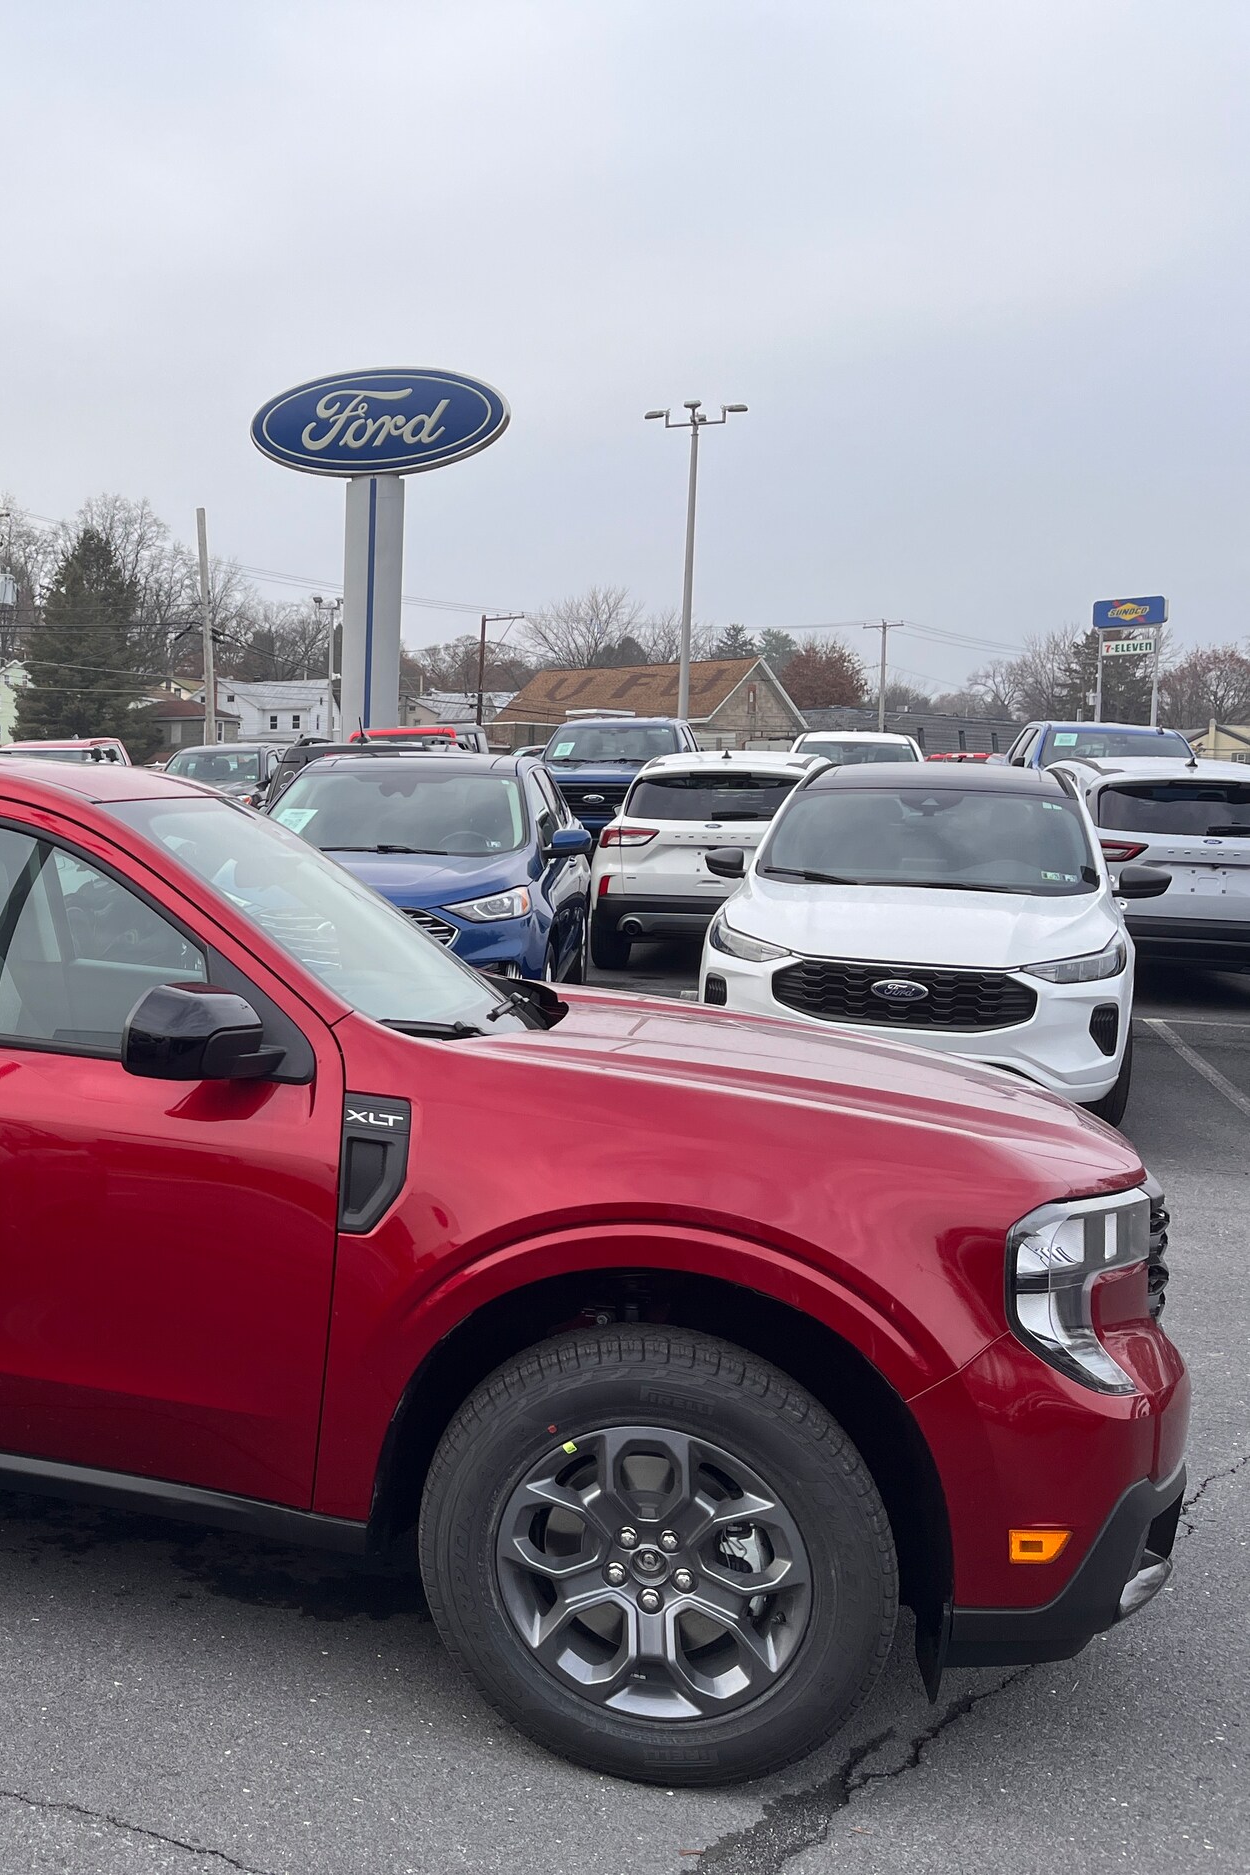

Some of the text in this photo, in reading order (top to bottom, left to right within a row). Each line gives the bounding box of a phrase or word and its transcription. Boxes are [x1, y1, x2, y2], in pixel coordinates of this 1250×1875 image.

[301, 388, 451, 451] Ford
[1109, 606, 1149, 617] SUNOCO
[346, 1109, 404, 1127] XLT
[639, 1385, 716, 1415] PIRELLI
